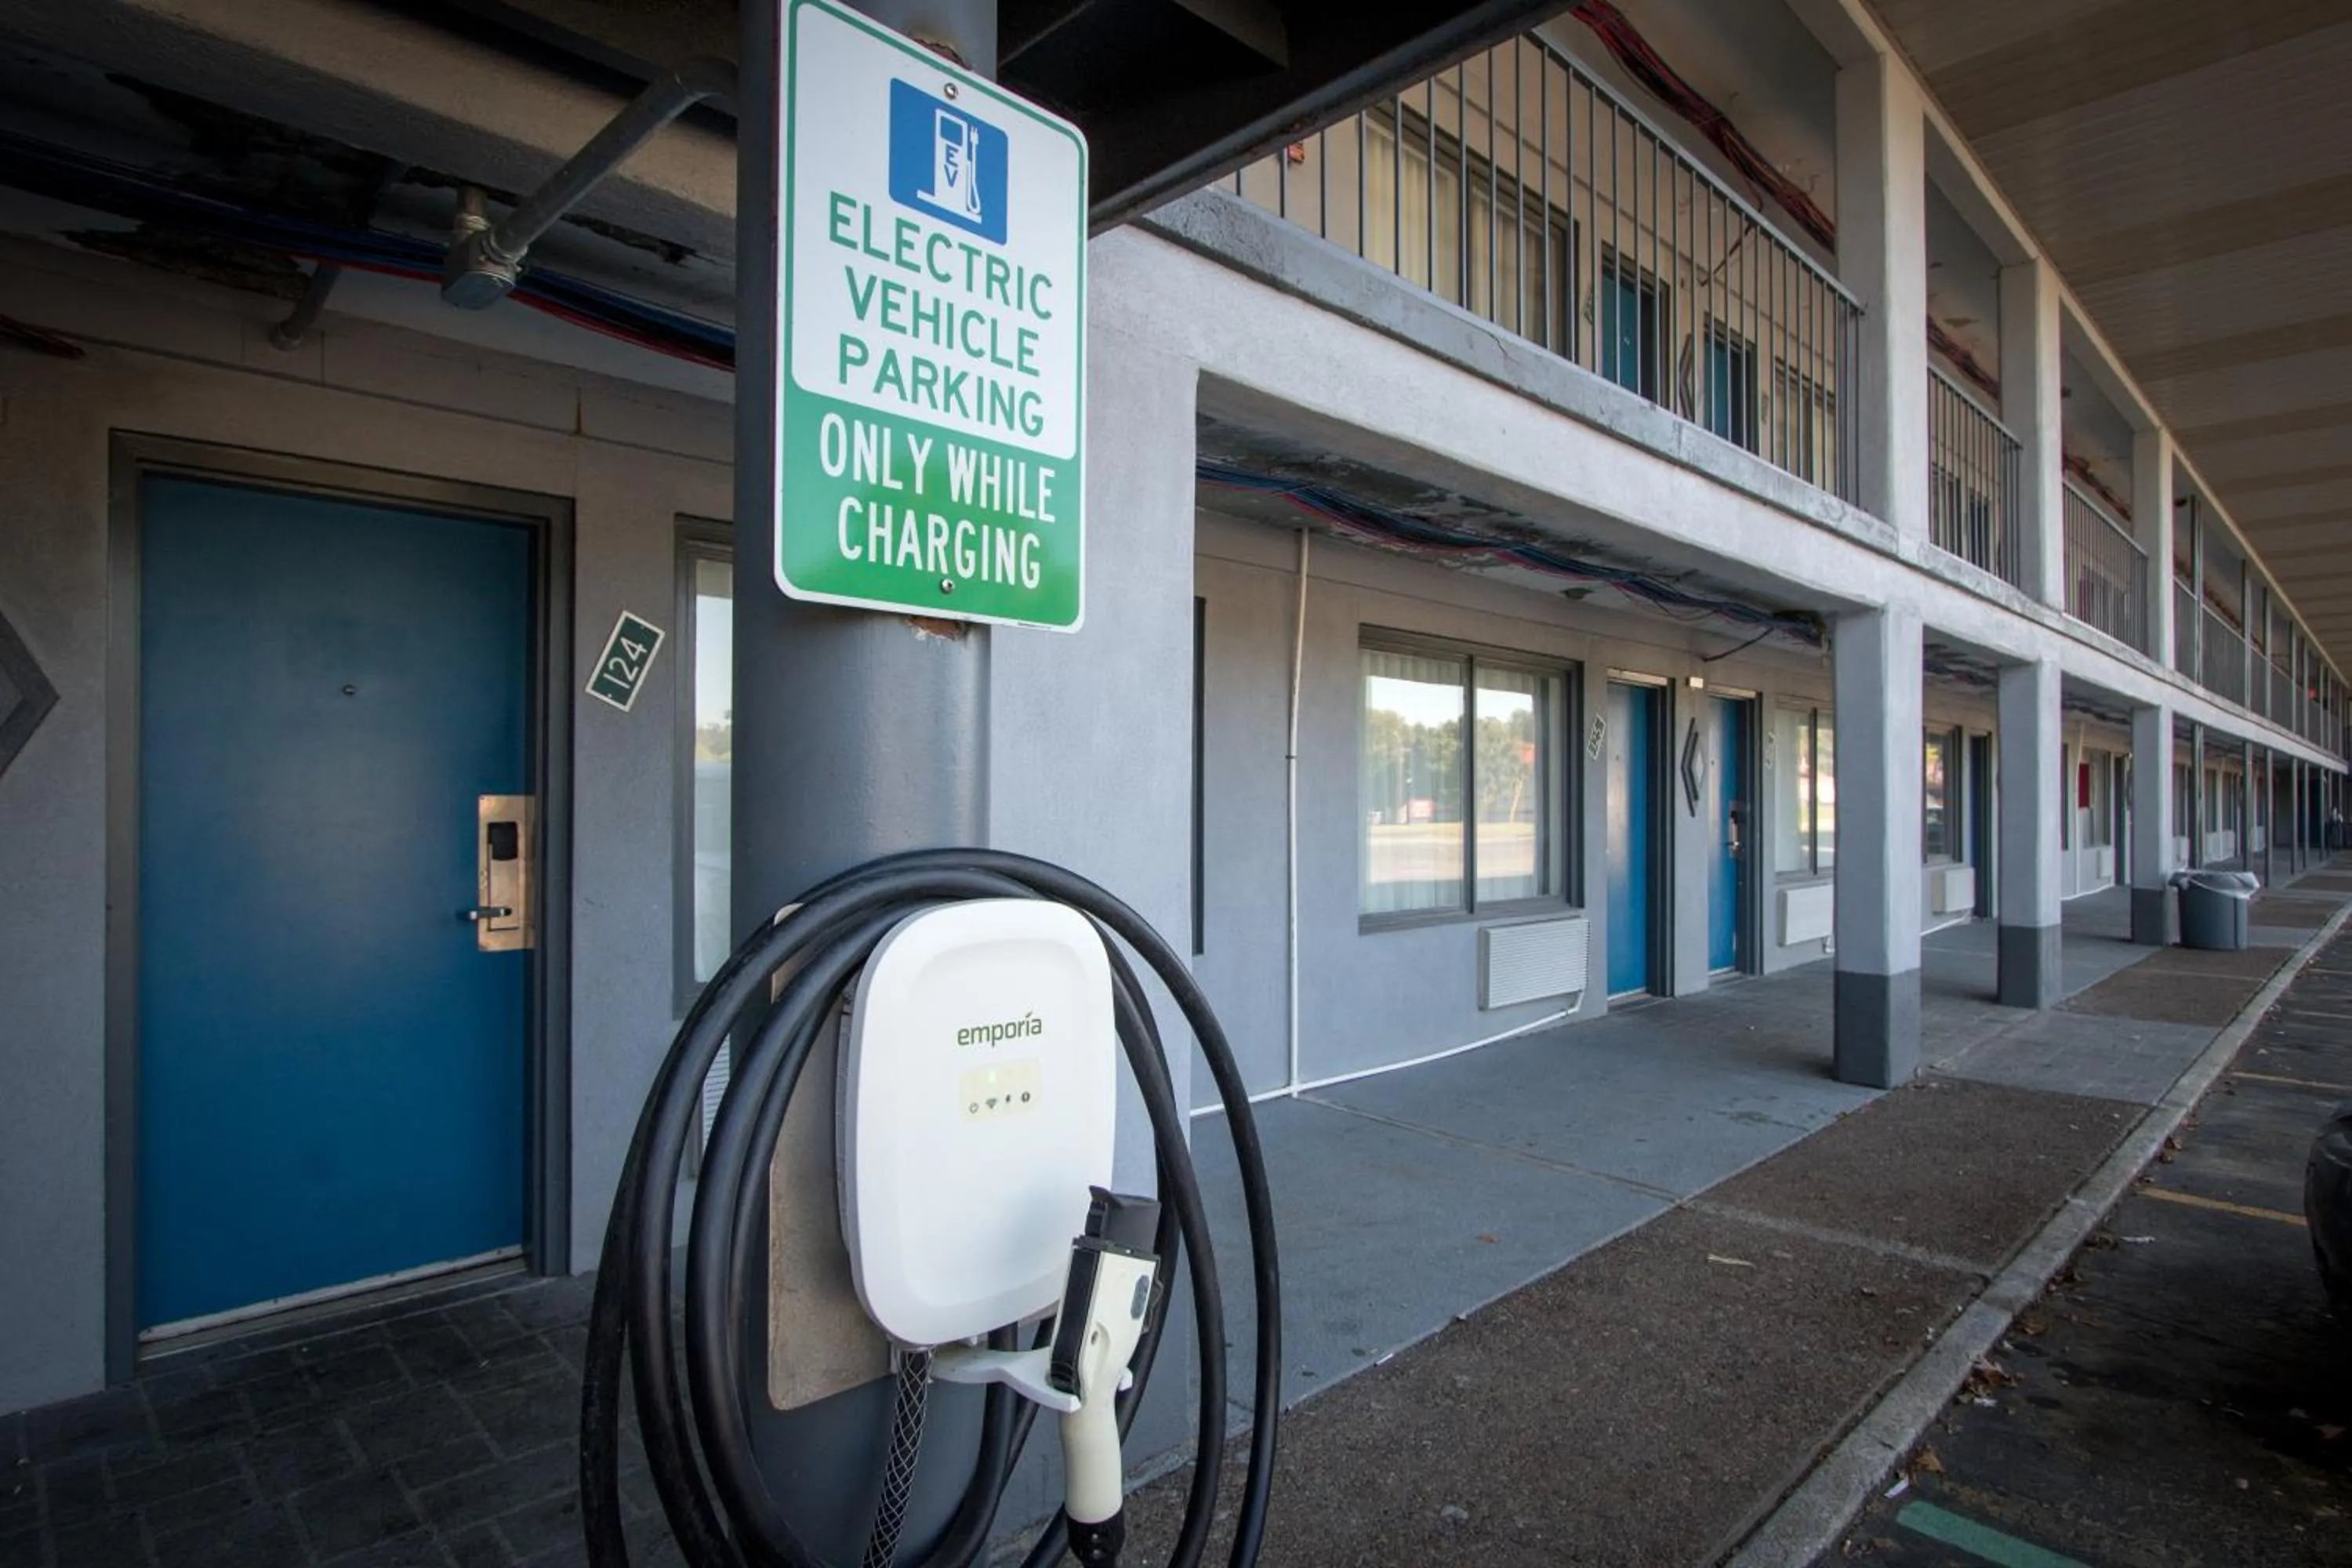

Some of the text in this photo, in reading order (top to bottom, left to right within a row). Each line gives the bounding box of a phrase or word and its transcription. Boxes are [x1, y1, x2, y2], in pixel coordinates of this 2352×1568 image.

[943, 144, 959, 187] EV
[829, 191, 1052, 321] ELECTRIC
[845, 265, 1040, 377] VEHICLE
[840, 333, 1044, 437] PARKING
[819, 412, 1055, 523] ONLY WHILE
[838, 496, 1040, 589] CHARGING
[603, 637, 648, 689] 124
